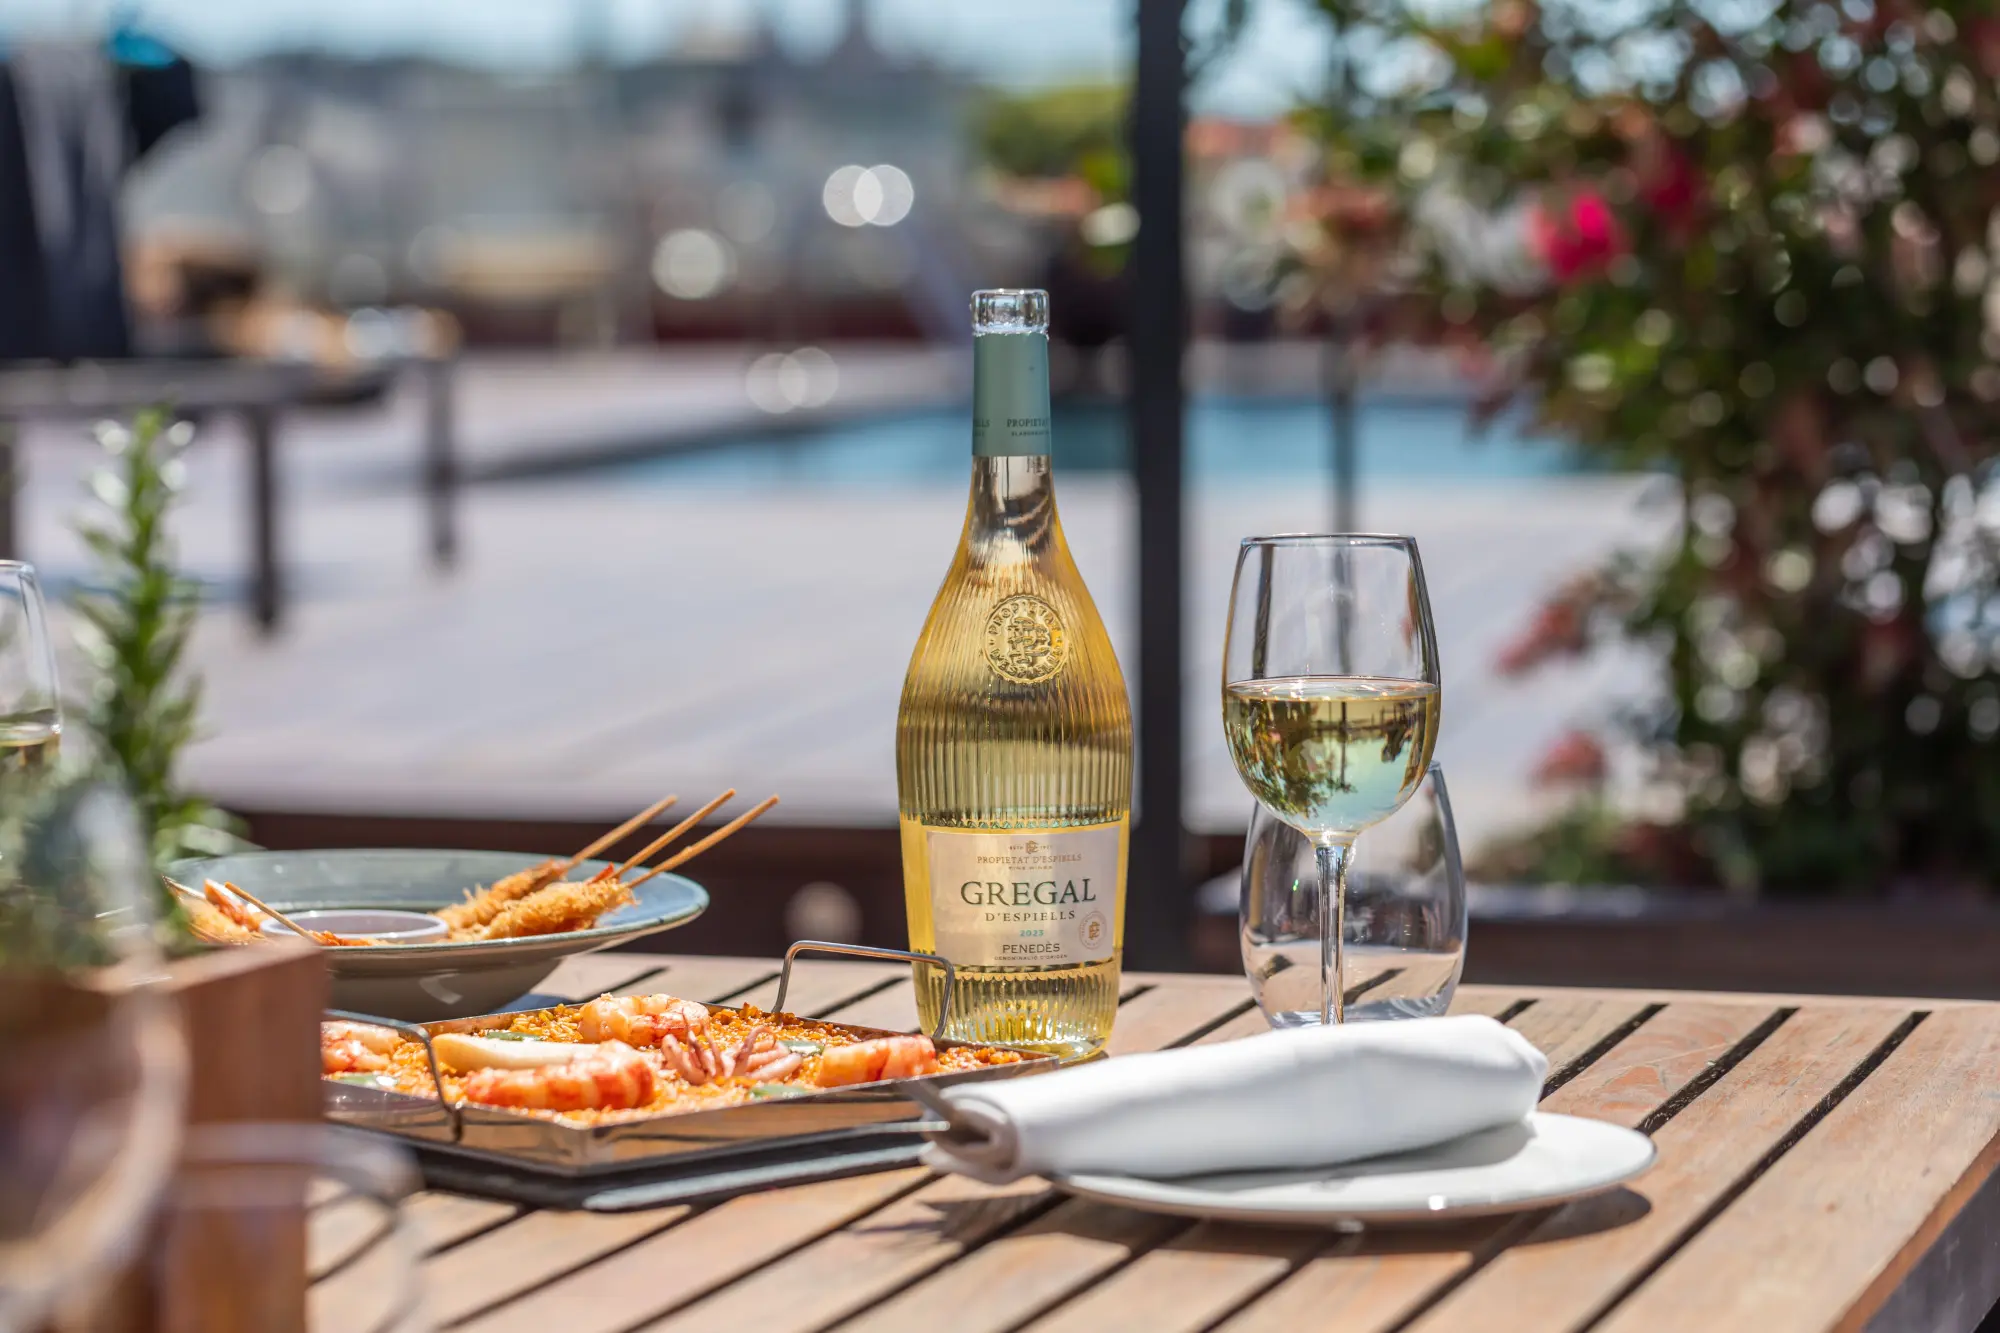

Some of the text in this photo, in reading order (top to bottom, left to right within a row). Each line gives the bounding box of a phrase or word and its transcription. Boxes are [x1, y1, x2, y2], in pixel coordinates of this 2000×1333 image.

[977, 853, 1082, 864] PROPIETAT D'ESPIELLS
[960, 878, 1096, 906] GREGAL
[985, 910, 1075, 921] D'ESPIELLS
[1020, 929, 1045, 937] 2023
[1002, 941, 1061, 954] PENEDÈS
